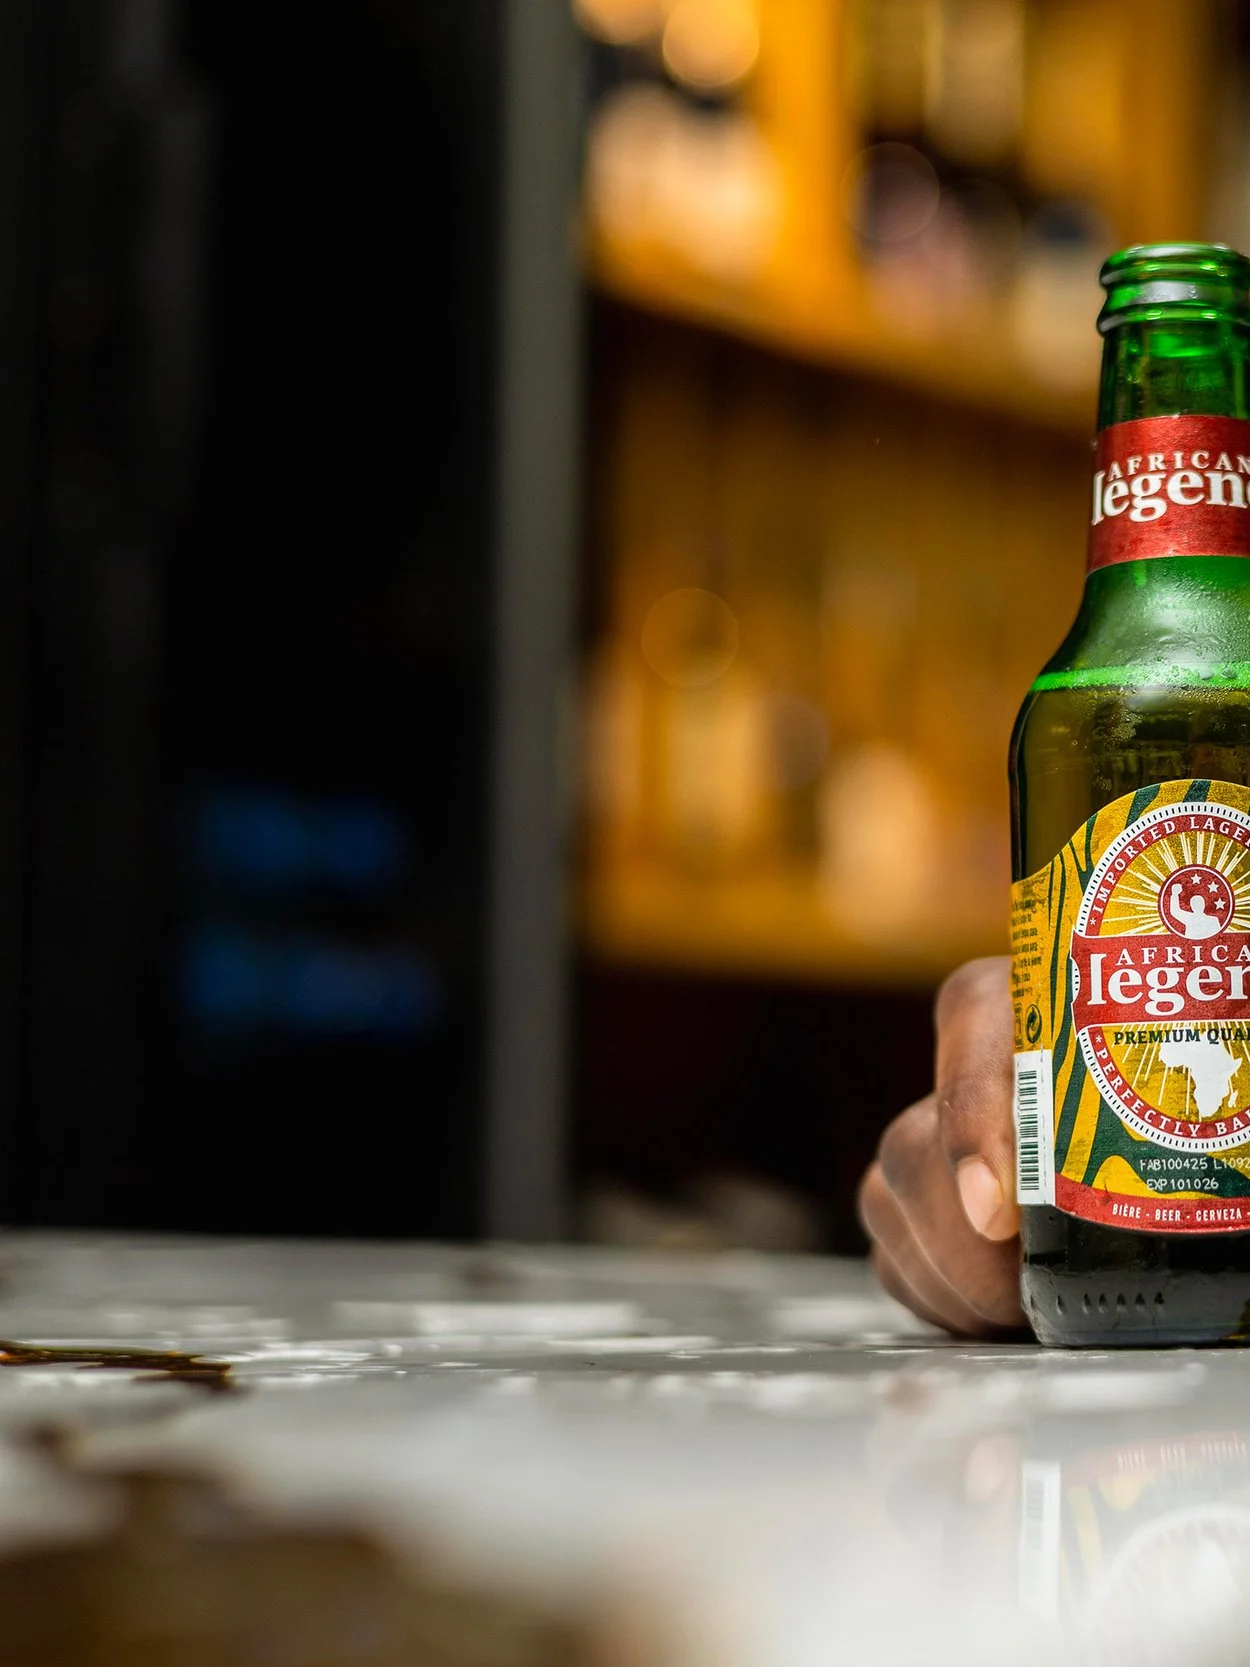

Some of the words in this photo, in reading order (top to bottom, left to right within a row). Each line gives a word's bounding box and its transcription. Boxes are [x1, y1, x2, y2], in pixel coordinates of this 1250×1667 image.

[1092, 820, 1177, 915] IMPORTED
[1113, 1029, 1200, 1045] PREMIUM
[1095, 1046, 1200, 1137] PERFECTLY
[1112, 1203, 1142, 1219] BIÈRE
[1154, 1208, 1182, 1222] BEER
[1195, 1207, 1242, 1222] CERVEZA
